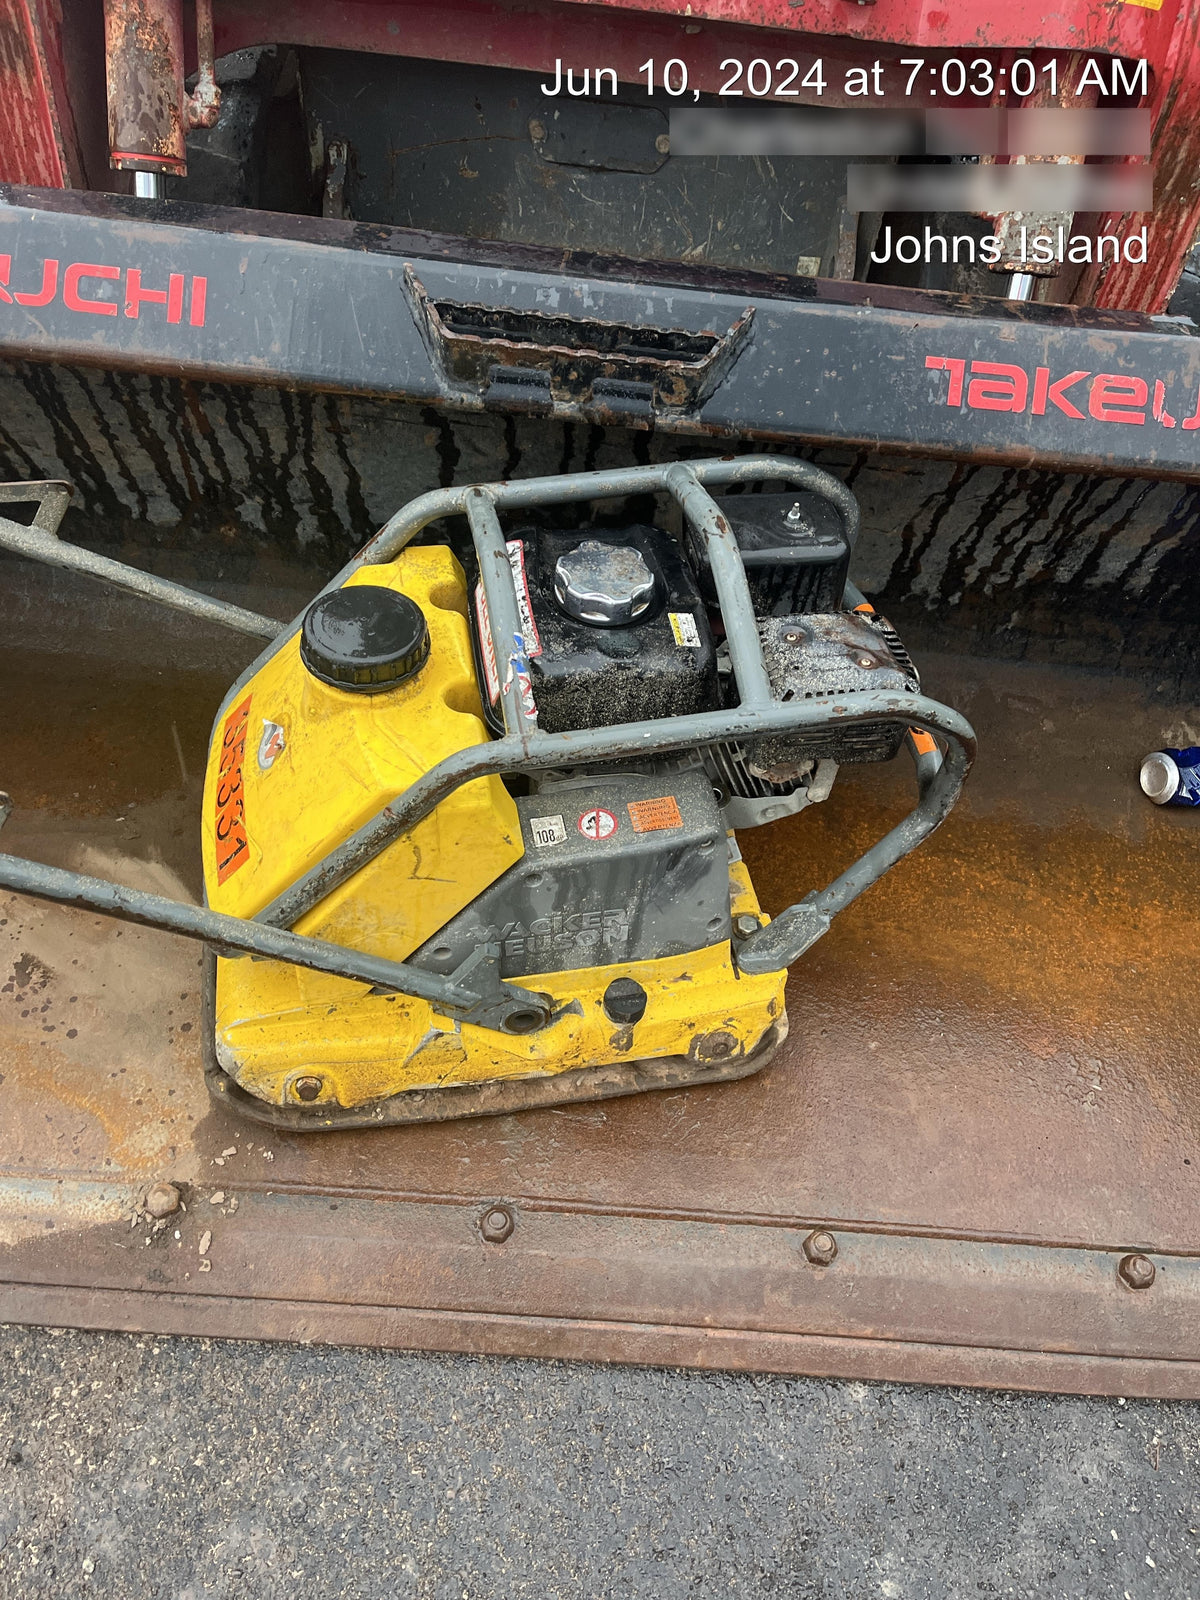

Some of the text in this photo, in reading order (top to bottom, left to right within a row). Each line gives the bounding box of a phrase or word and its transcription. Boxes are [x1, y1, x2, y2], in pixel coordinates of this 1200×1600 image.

[536, 829, 556, 844] 108
[470, 908, 629, 943] WACKER
[474, 924, 629, 957] EUSON
